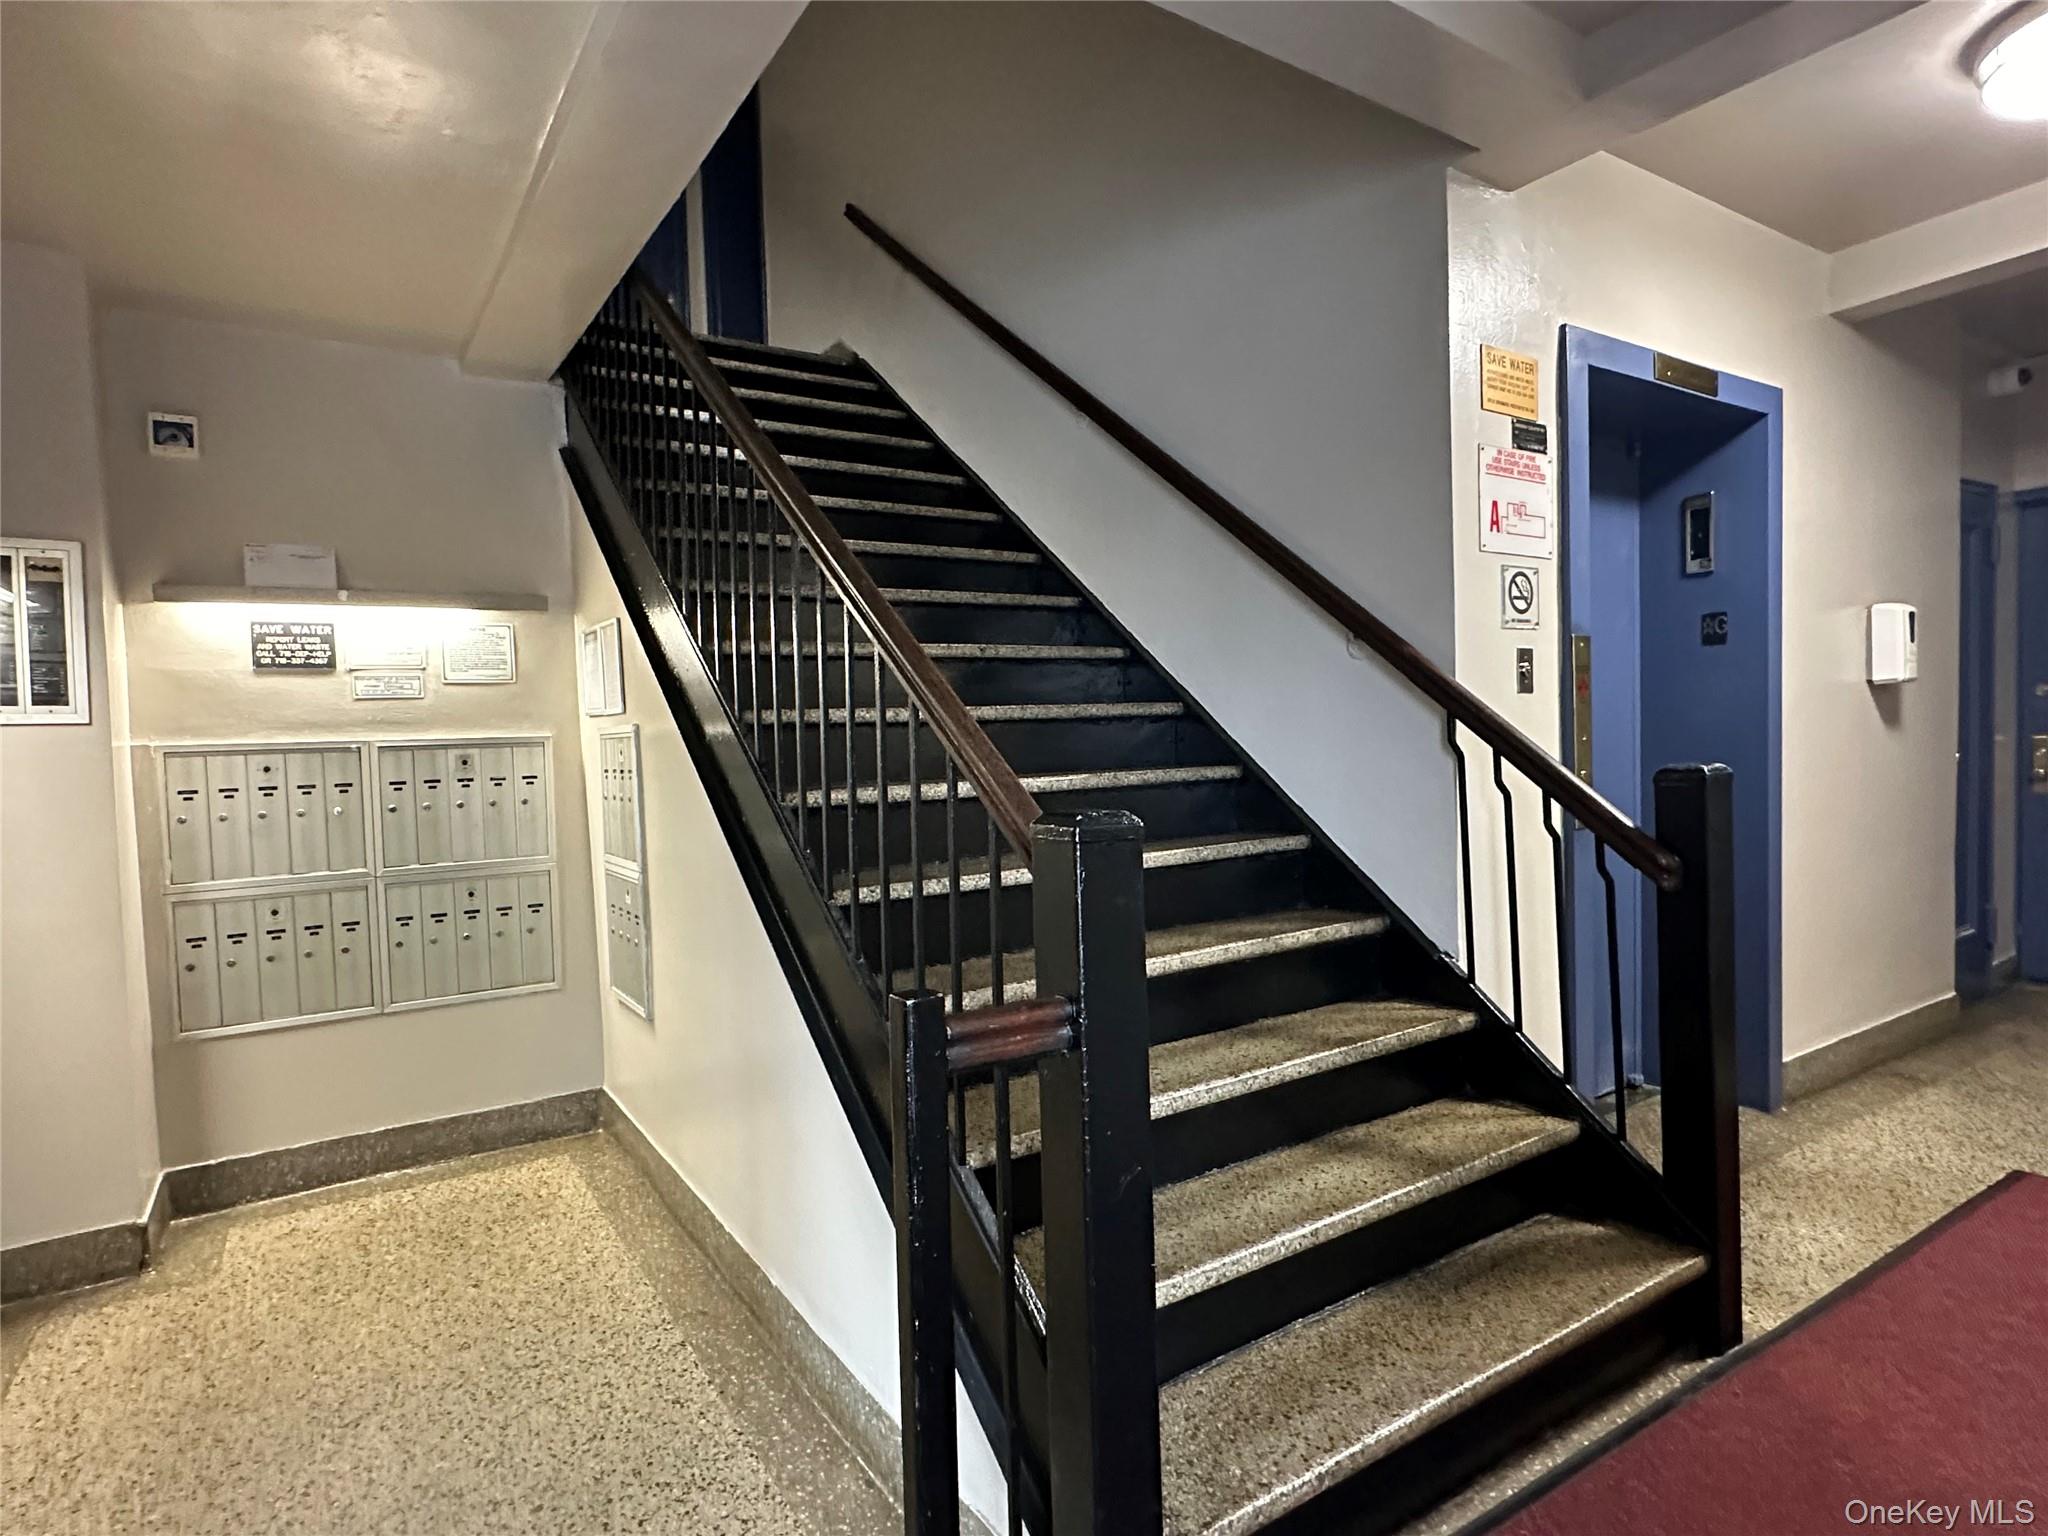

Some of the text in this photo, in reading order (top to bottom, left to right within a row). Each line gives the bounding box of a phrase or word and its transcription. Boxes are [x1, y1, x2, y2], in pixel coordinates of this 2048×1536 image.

[1486, 351, 1535, 376] SAVE WATER
[1496, 448, 1503, 457] IN
[1503, 450, 1517, 459] CASE
[1490, 500, 1500, 533] A
[252, 623, 333, 635] SAVE WATER
